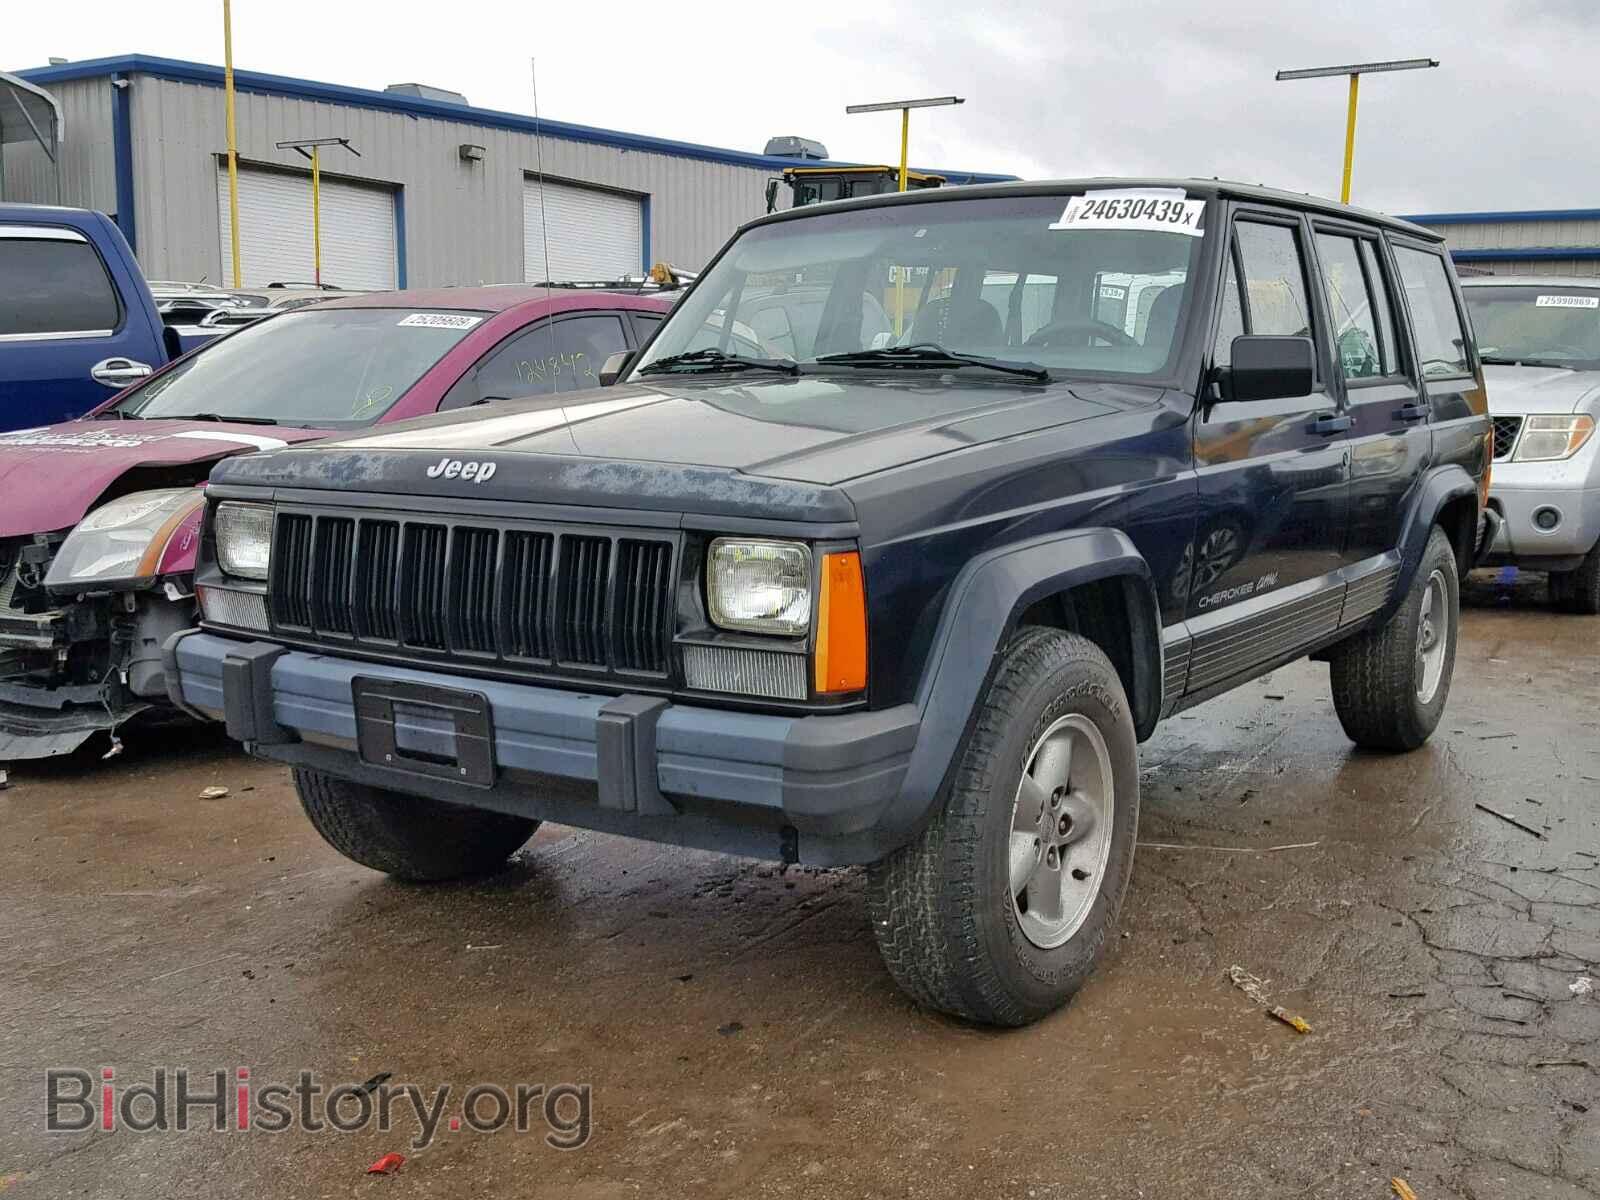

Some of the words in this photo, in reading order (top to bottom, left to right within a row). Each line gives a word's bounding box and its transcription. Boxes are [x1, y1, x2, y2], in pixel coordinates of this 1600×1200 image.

[888, 265, 913, 283] CT
[426, 458, 498, 484] Jeep
[1198, 581, 1254, 608] CHEROKEE
